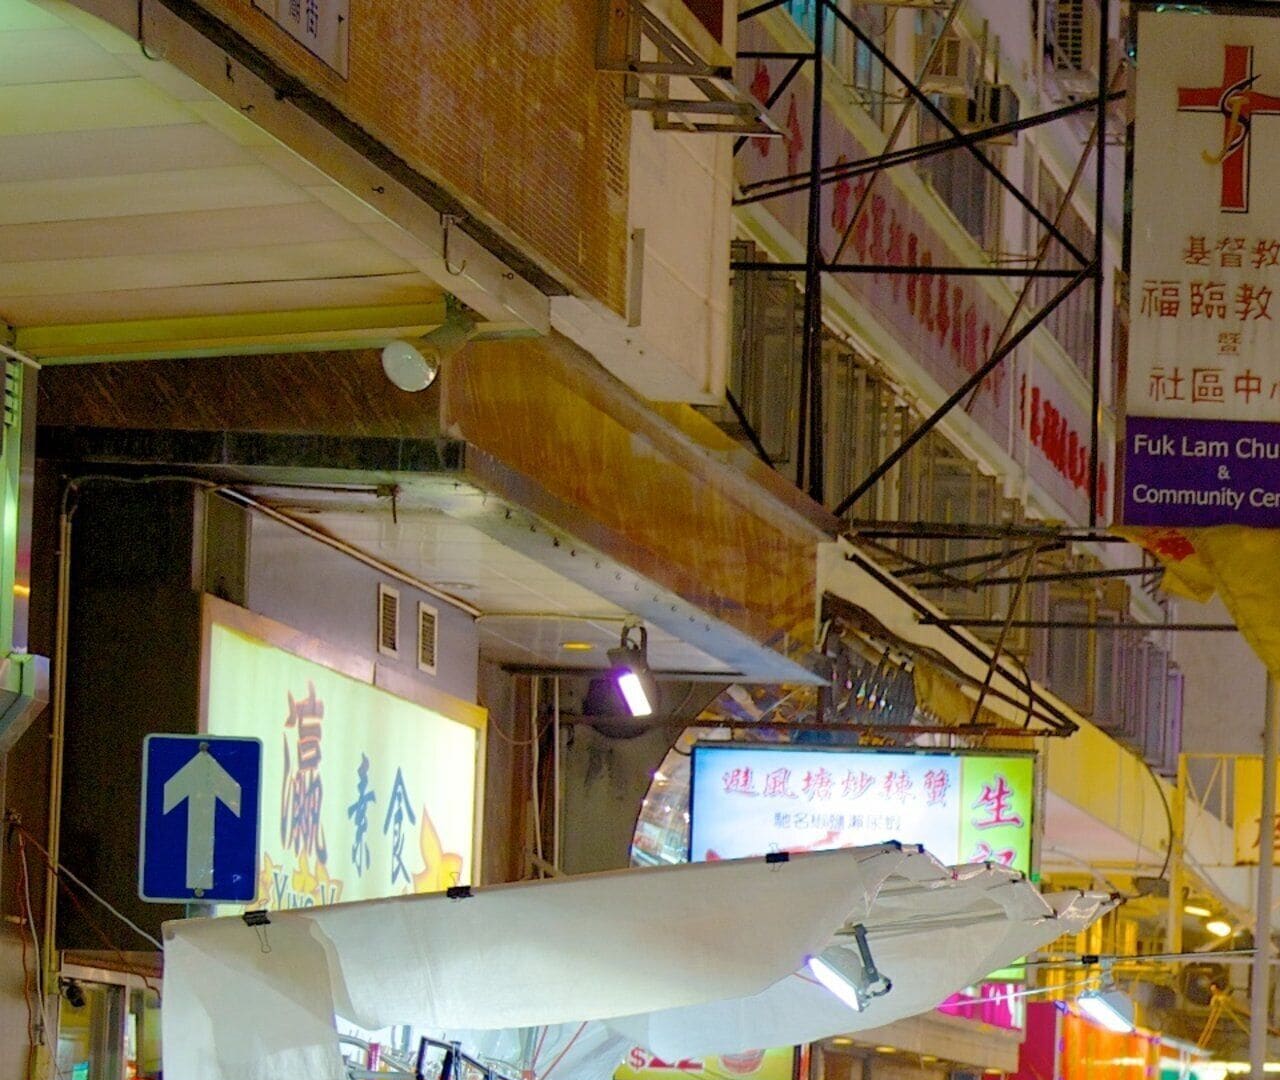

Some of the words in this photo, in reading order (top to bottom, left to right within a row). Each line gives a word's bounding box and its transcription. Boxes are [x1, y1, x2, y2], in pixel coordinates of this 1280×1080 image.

[1134, 435, 1175, 456] Fuk
[1182, 436, 1229, 458] Lam
[1217, 465, 1230, 480] &
[1132, 484, 1245, 511] Community
